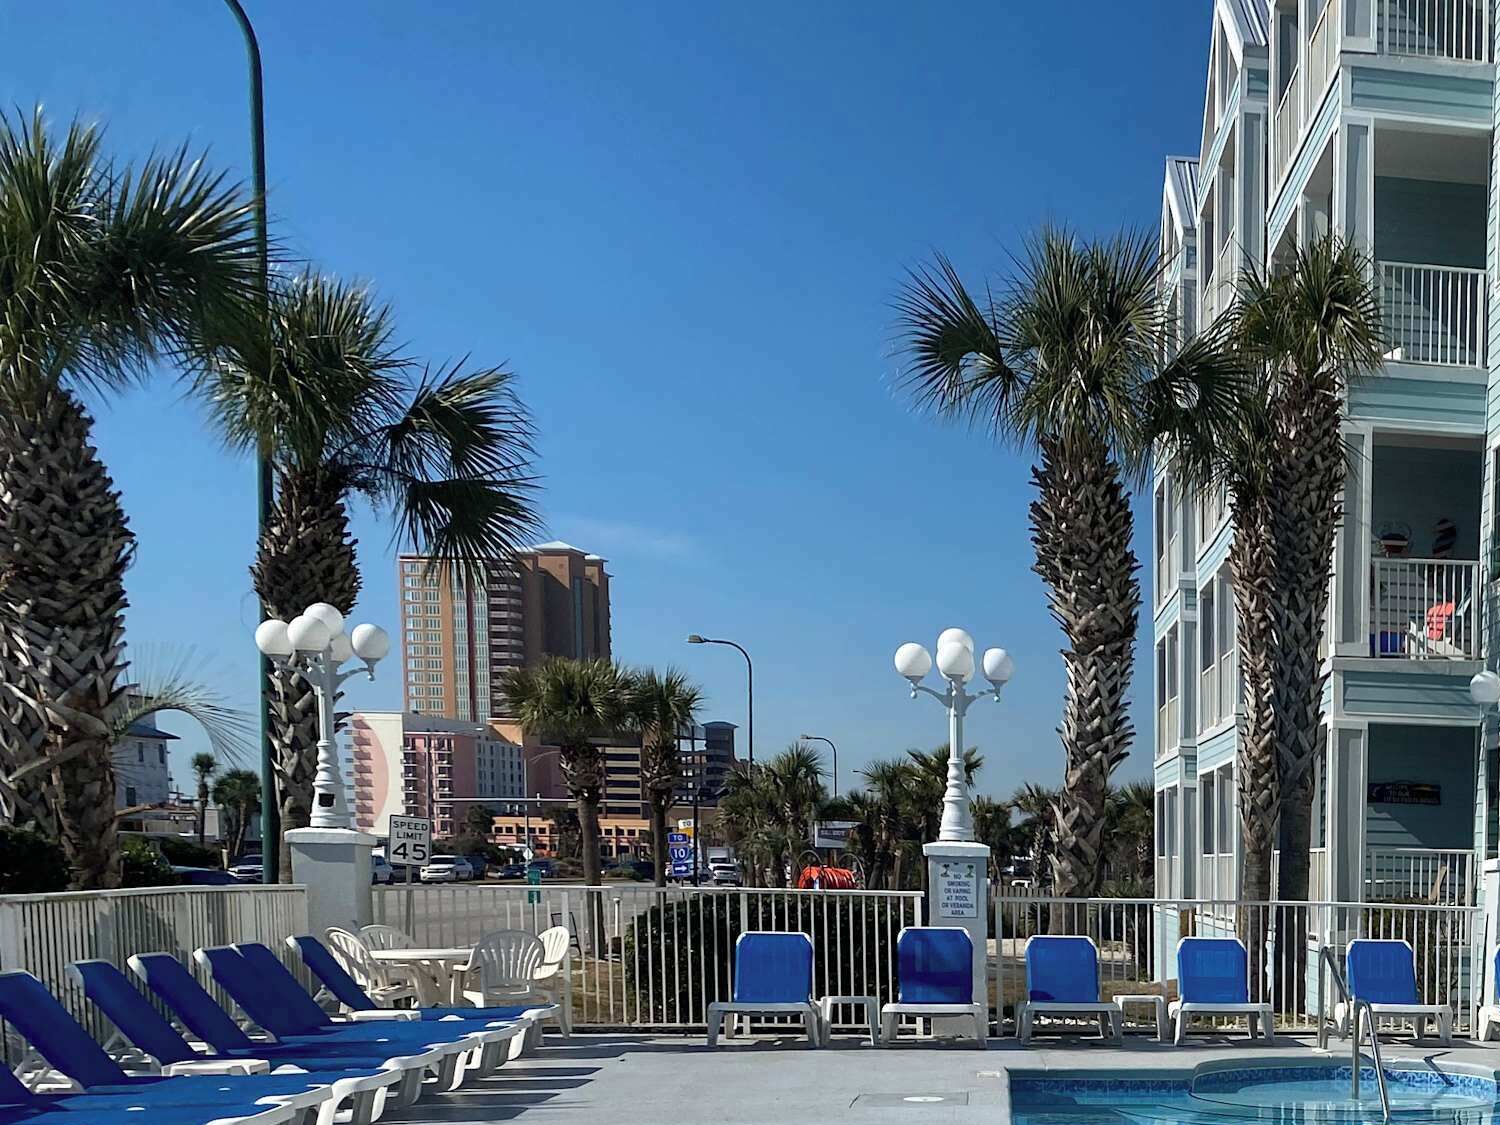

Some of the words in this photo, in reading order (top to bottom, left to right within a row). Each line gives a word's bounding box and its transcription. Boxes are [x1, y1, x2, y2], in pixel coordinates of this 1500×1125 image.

[393, 820, 428, 831] SPEED
[396, 831, 423, 840] LIMIT
[392, 842, 427, 861] 45
[673, 848, 686, 859] 10
